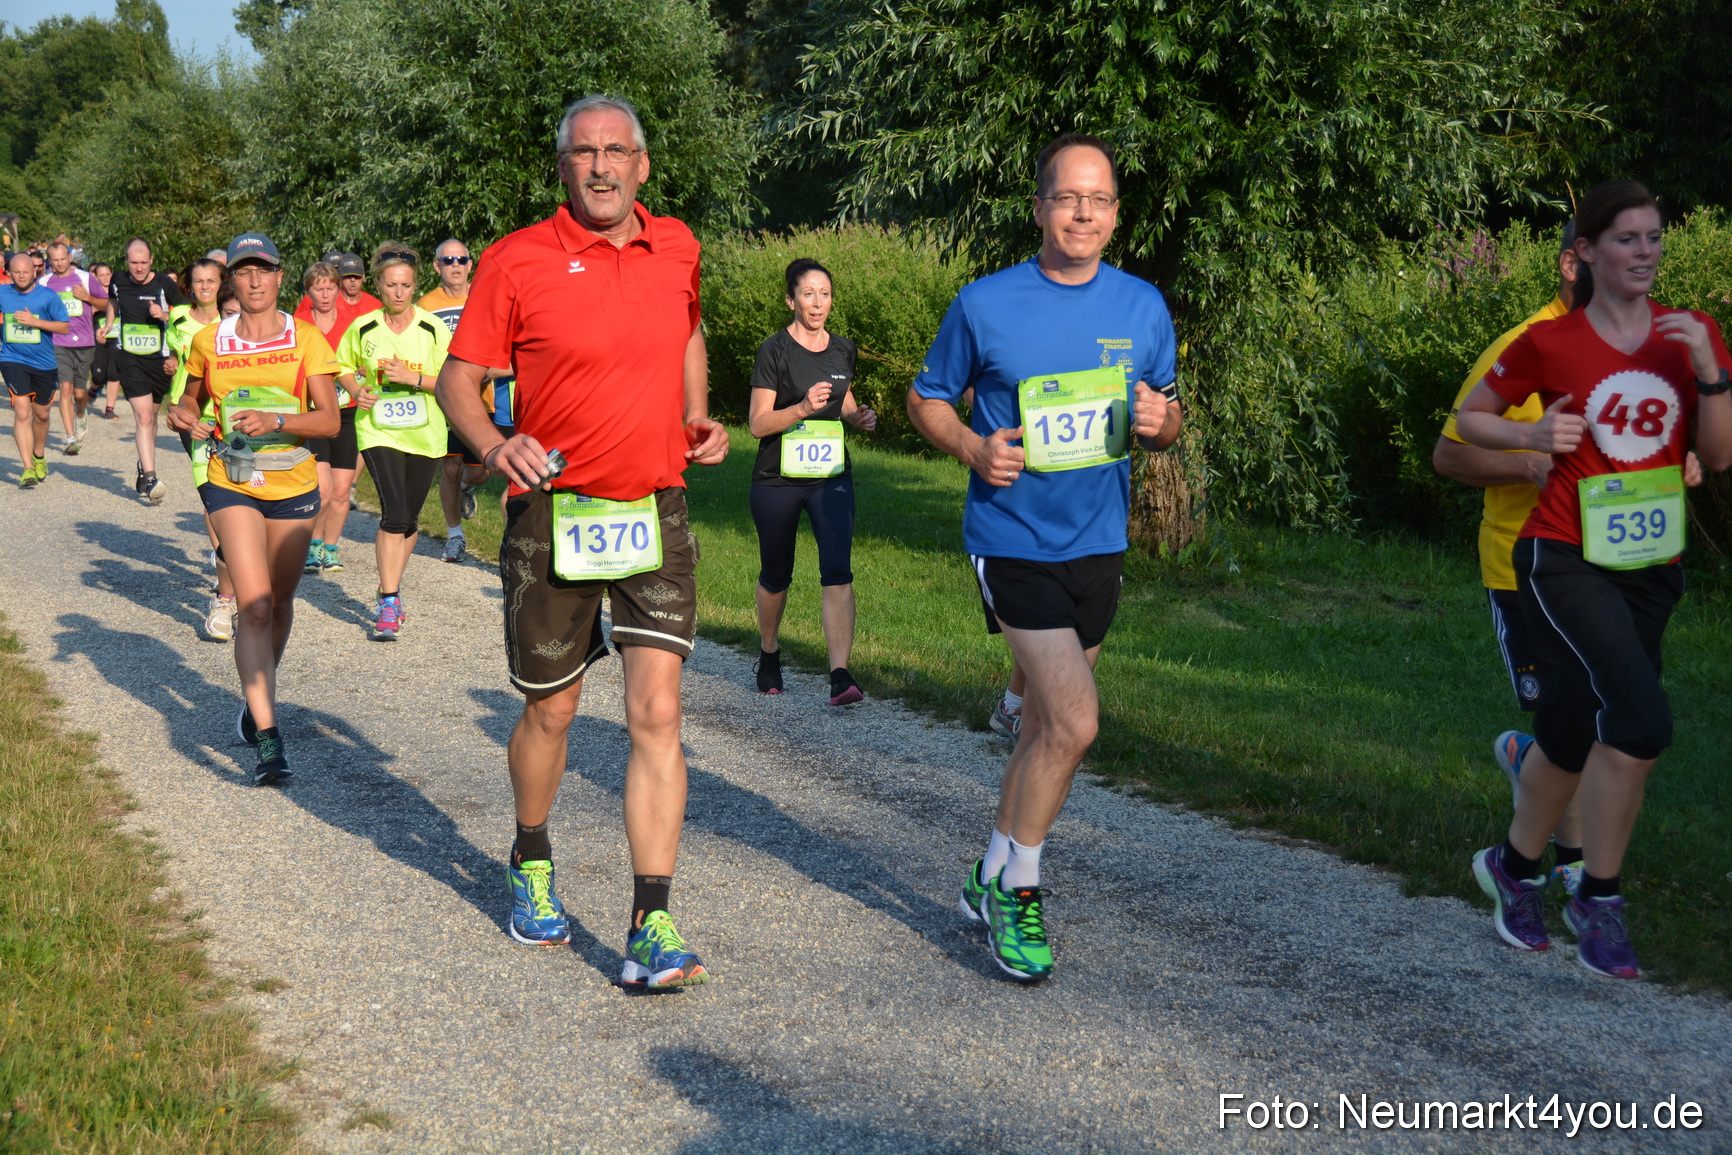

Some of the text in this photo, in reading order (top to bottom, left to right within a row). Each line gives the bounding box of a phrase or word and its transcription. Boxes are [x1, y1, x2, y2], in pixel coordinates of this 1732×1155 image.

[127, 336, 157, 346] 1073
[216, 353, 299, 370] MAX BÖGL
[383, 400, 417, 418] 339
[1035, 406, 1114, 445] 1371
[795, 444, 832, 462] 102
[1048, 449, 1080, 458] Christoph
[569, 500, 606, 508] firmenlauf
[1606, 508, 1666, 544] 539
[566, 521, 649, 554] 1370
